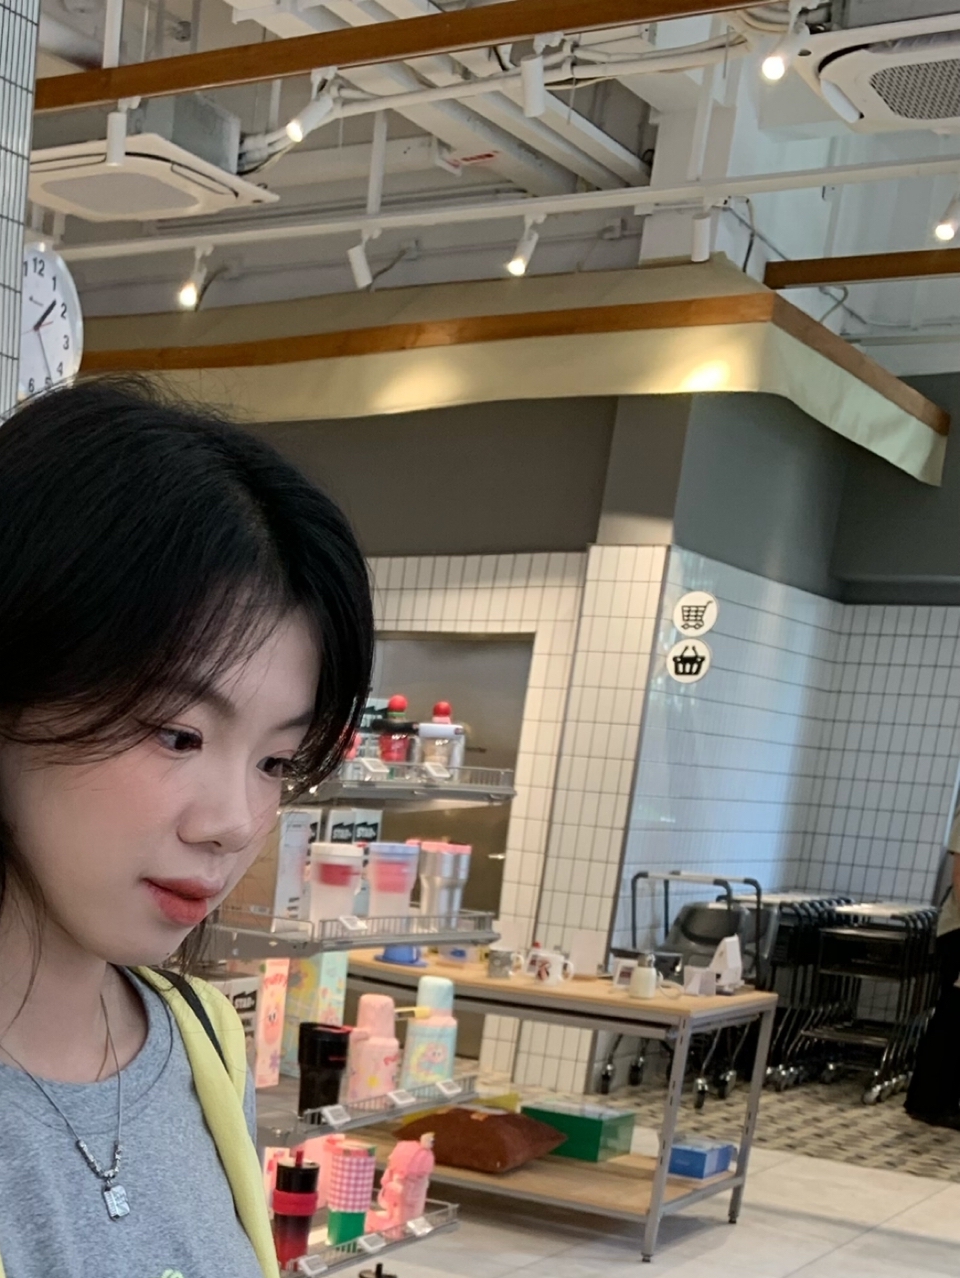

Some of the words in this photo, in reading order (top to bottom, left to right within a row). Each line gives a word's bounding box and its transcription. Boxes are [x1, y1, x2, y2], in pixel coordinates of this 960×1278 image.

[32, 256, 45, 277] 12
[51, 275, 57, 292] 1
[60, 303, 68, 319] 2
[62, 334, 69, 351] 3
[56, 361, 64, 377] 4
[28, 377, 35, 393] 6
